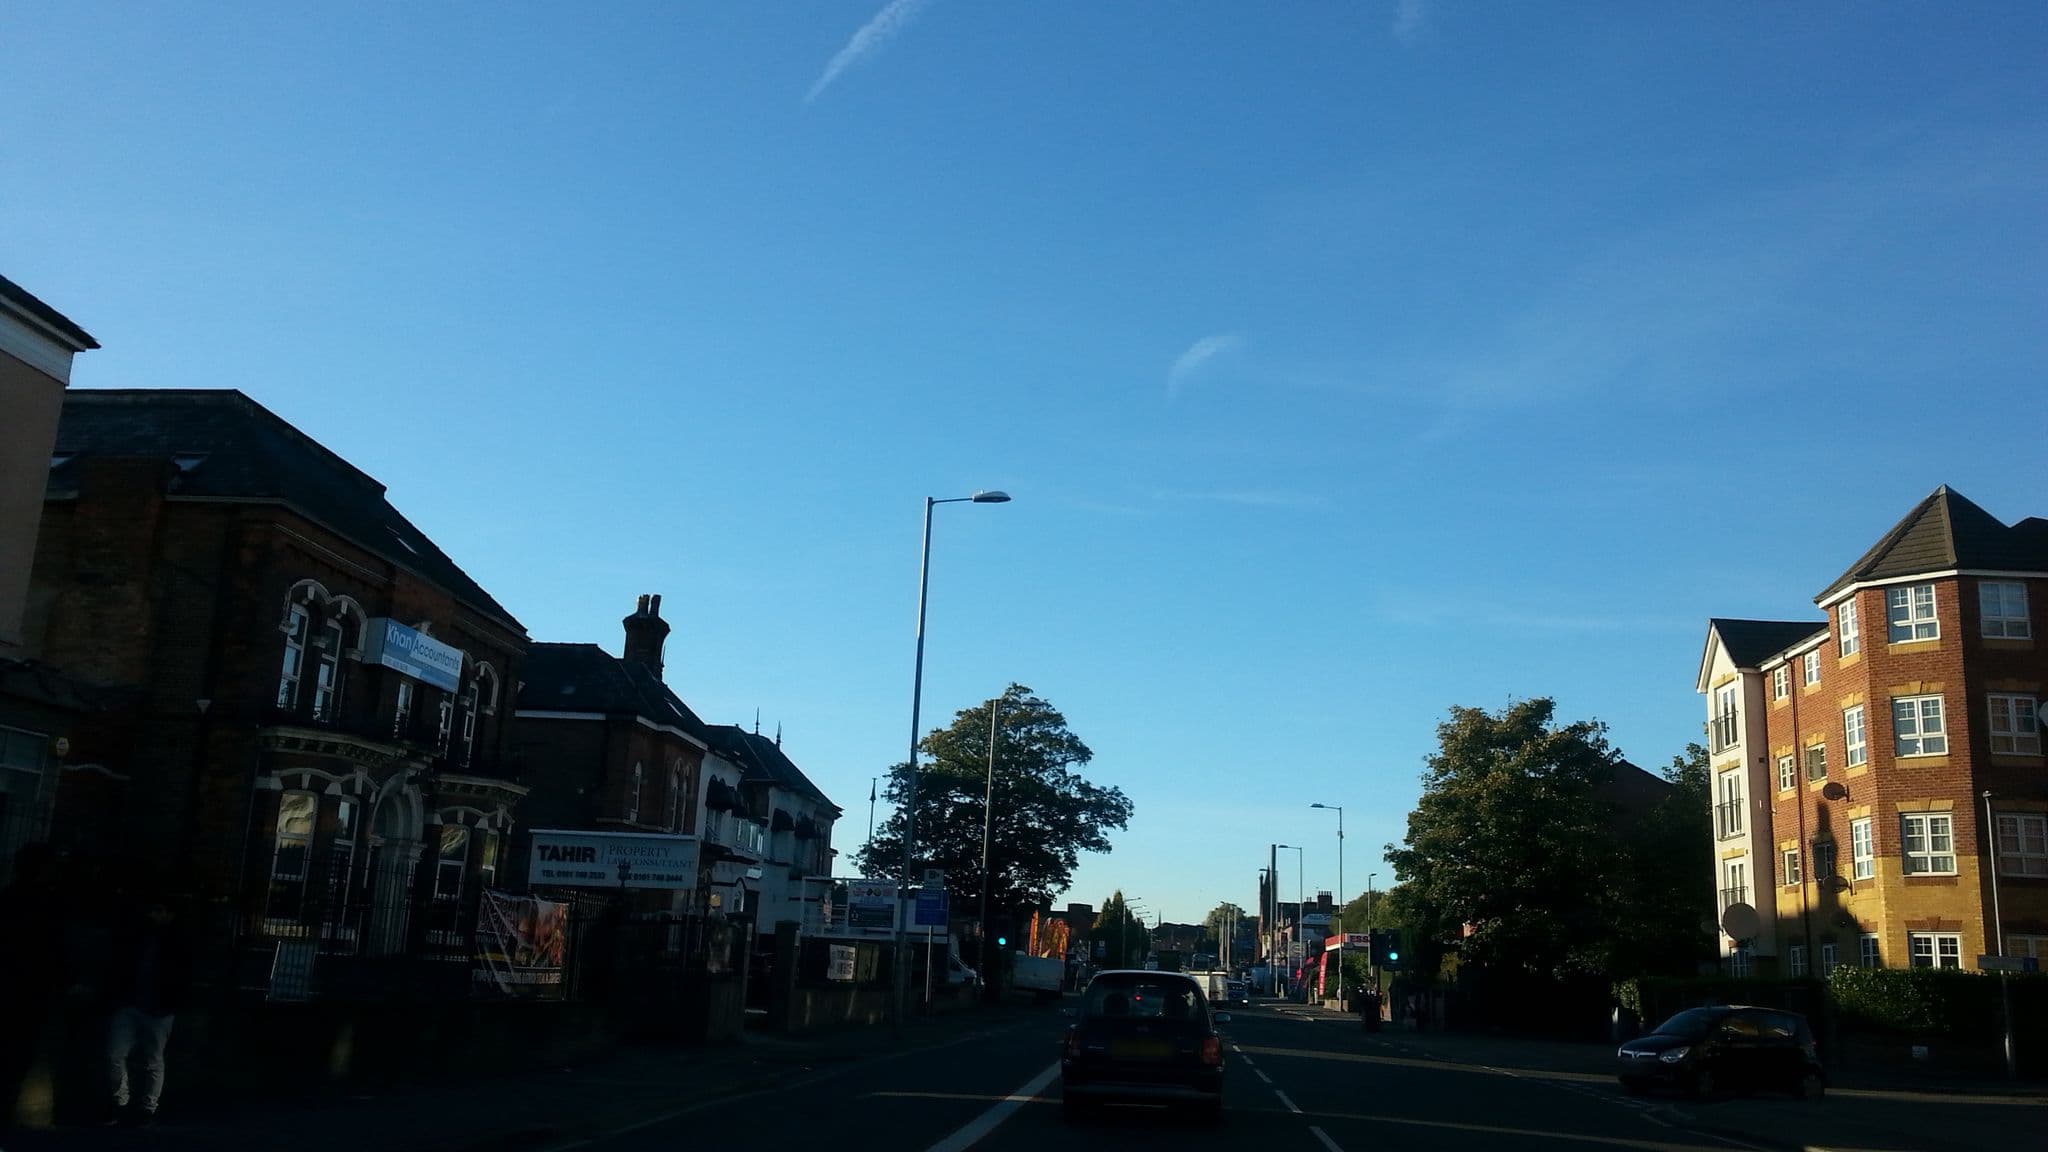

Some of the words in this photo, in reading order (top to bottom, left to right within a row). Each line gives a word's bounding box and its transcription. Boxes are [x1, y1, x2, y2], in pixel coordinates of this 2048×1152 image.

[387, 623, 412, 650] Khan
[413, 639, 460, 670] Accountants
[538, 845, 595, 863] TAHIR
[609, 846, 670, 857] PROPERTY
